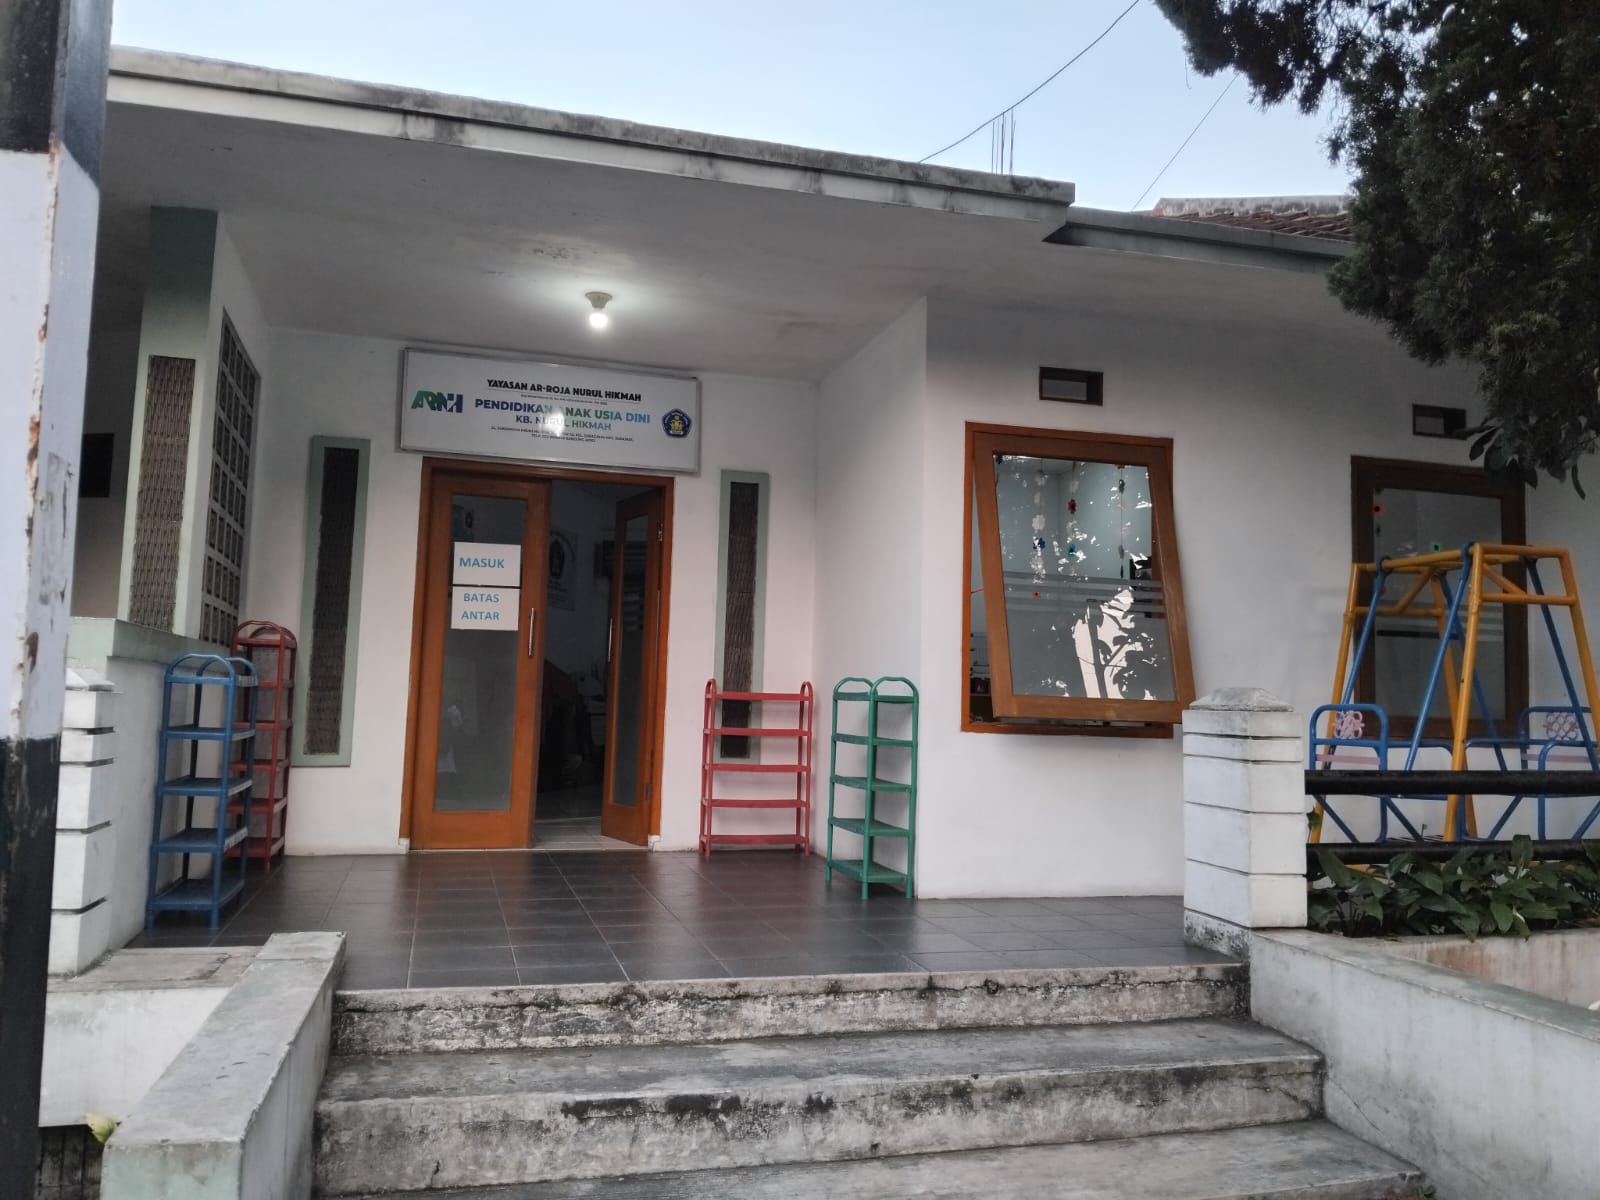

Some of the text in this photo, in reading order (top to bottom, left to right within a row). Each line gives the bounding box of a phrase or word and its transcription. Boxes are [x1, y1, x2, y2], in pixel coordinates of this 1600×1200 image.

[487, 378, 528, 391] YAYASAN
[529, 382, 571, 396] AR-ROJA
[573, 386, 603, 399] NURUL
[605, 389, 641, 402] HIKMAH
[475, 398, 553, 415] PENDIDIKAN
[595, 410, 622, 422] USIA
[625, 412, 651, 424] DINI
[515, 415, 533, 426] KB.
[571, 420, 612, 431] HIKMAH
[459, 557, 505, 569] MASUK
[463, 592, 500, 603] BATAS
[461, 611, 500, 621] ANTAR
